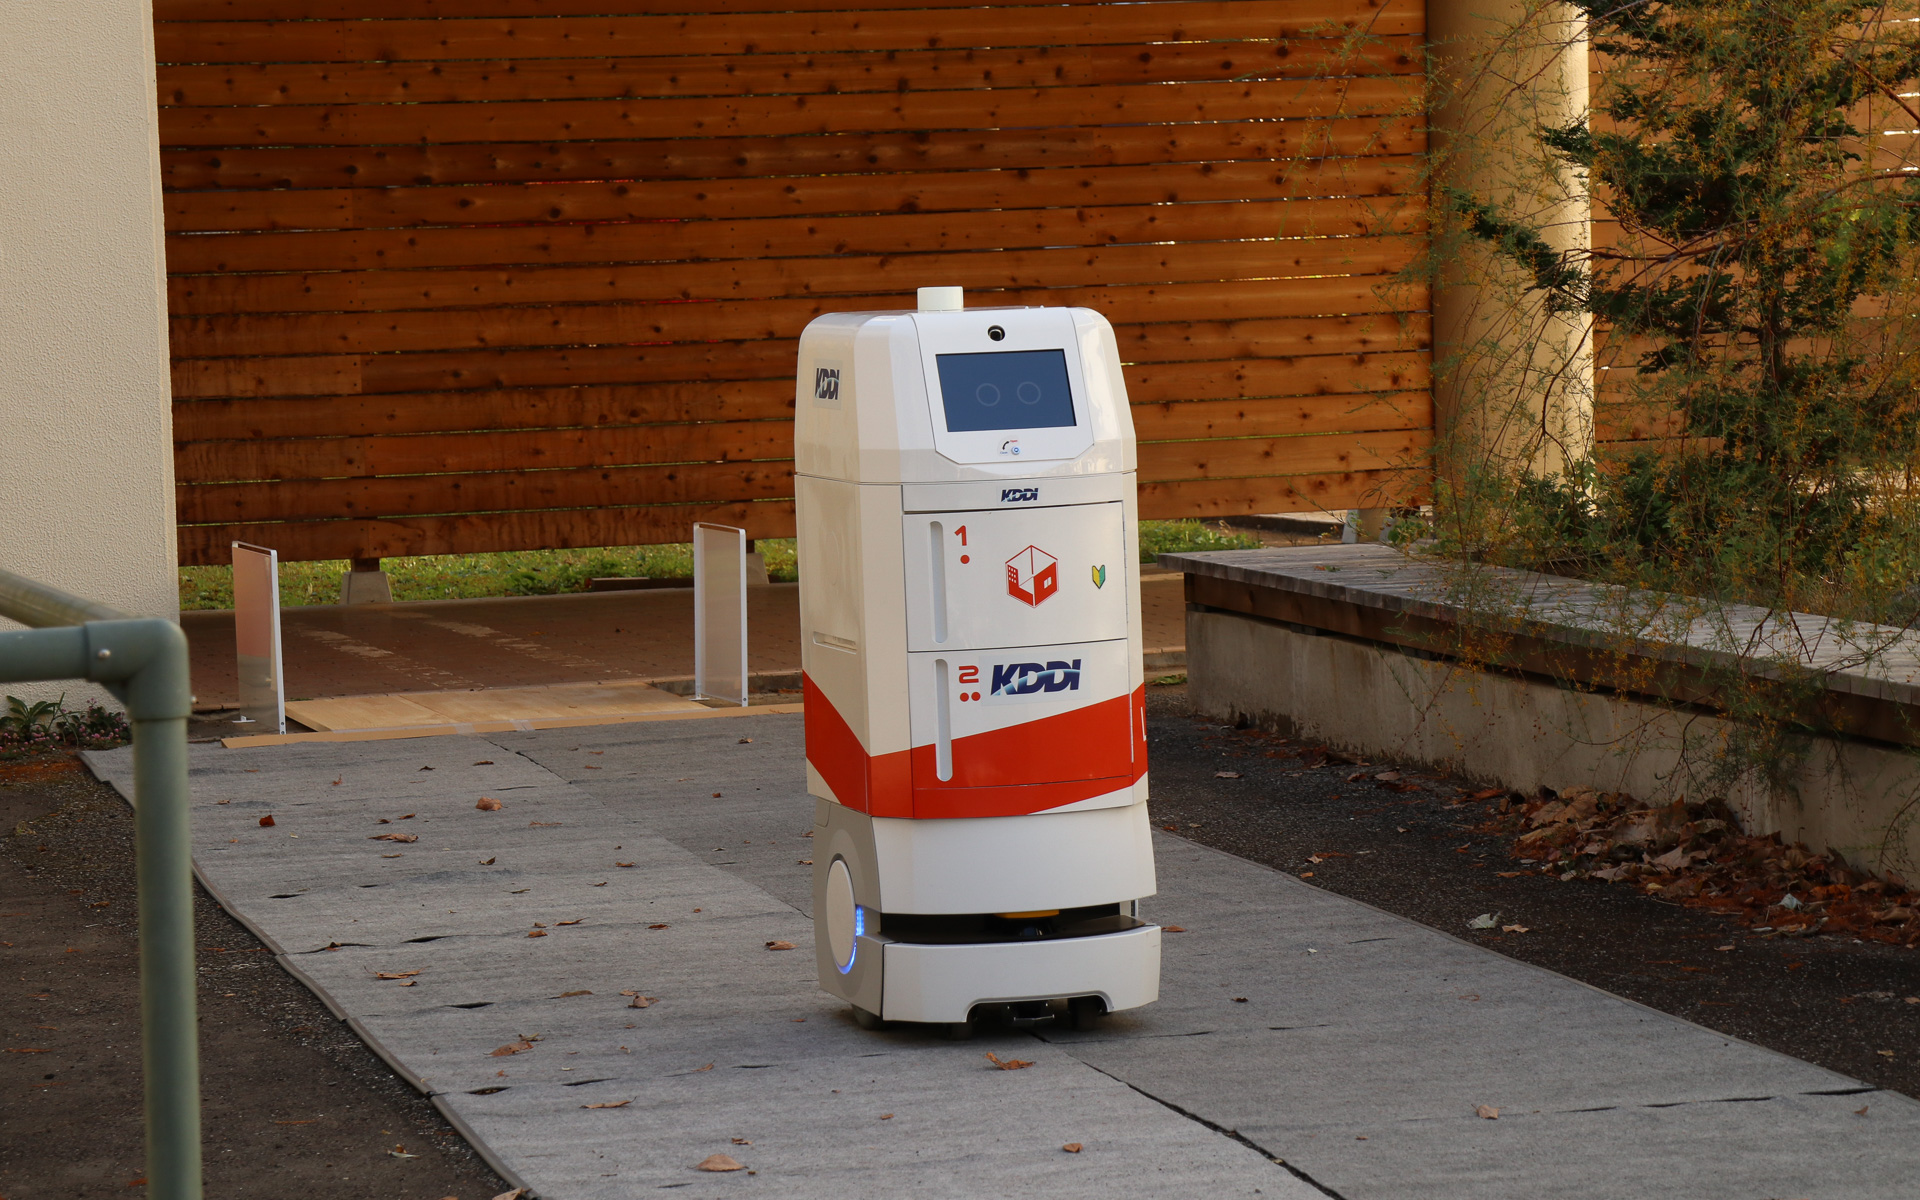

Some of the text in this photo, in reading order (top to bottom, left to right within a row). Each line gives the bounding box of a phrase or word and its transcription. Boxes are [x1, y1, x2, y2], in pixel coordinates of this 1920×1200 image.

[815, 367, 840, 401] KDDI
[1001, 487, 1039, 502] KDDI
[954, 525, 968, 546] 1
[958, 665, 980, 684] 2
[990, 659, 1082, 697] KDDI
